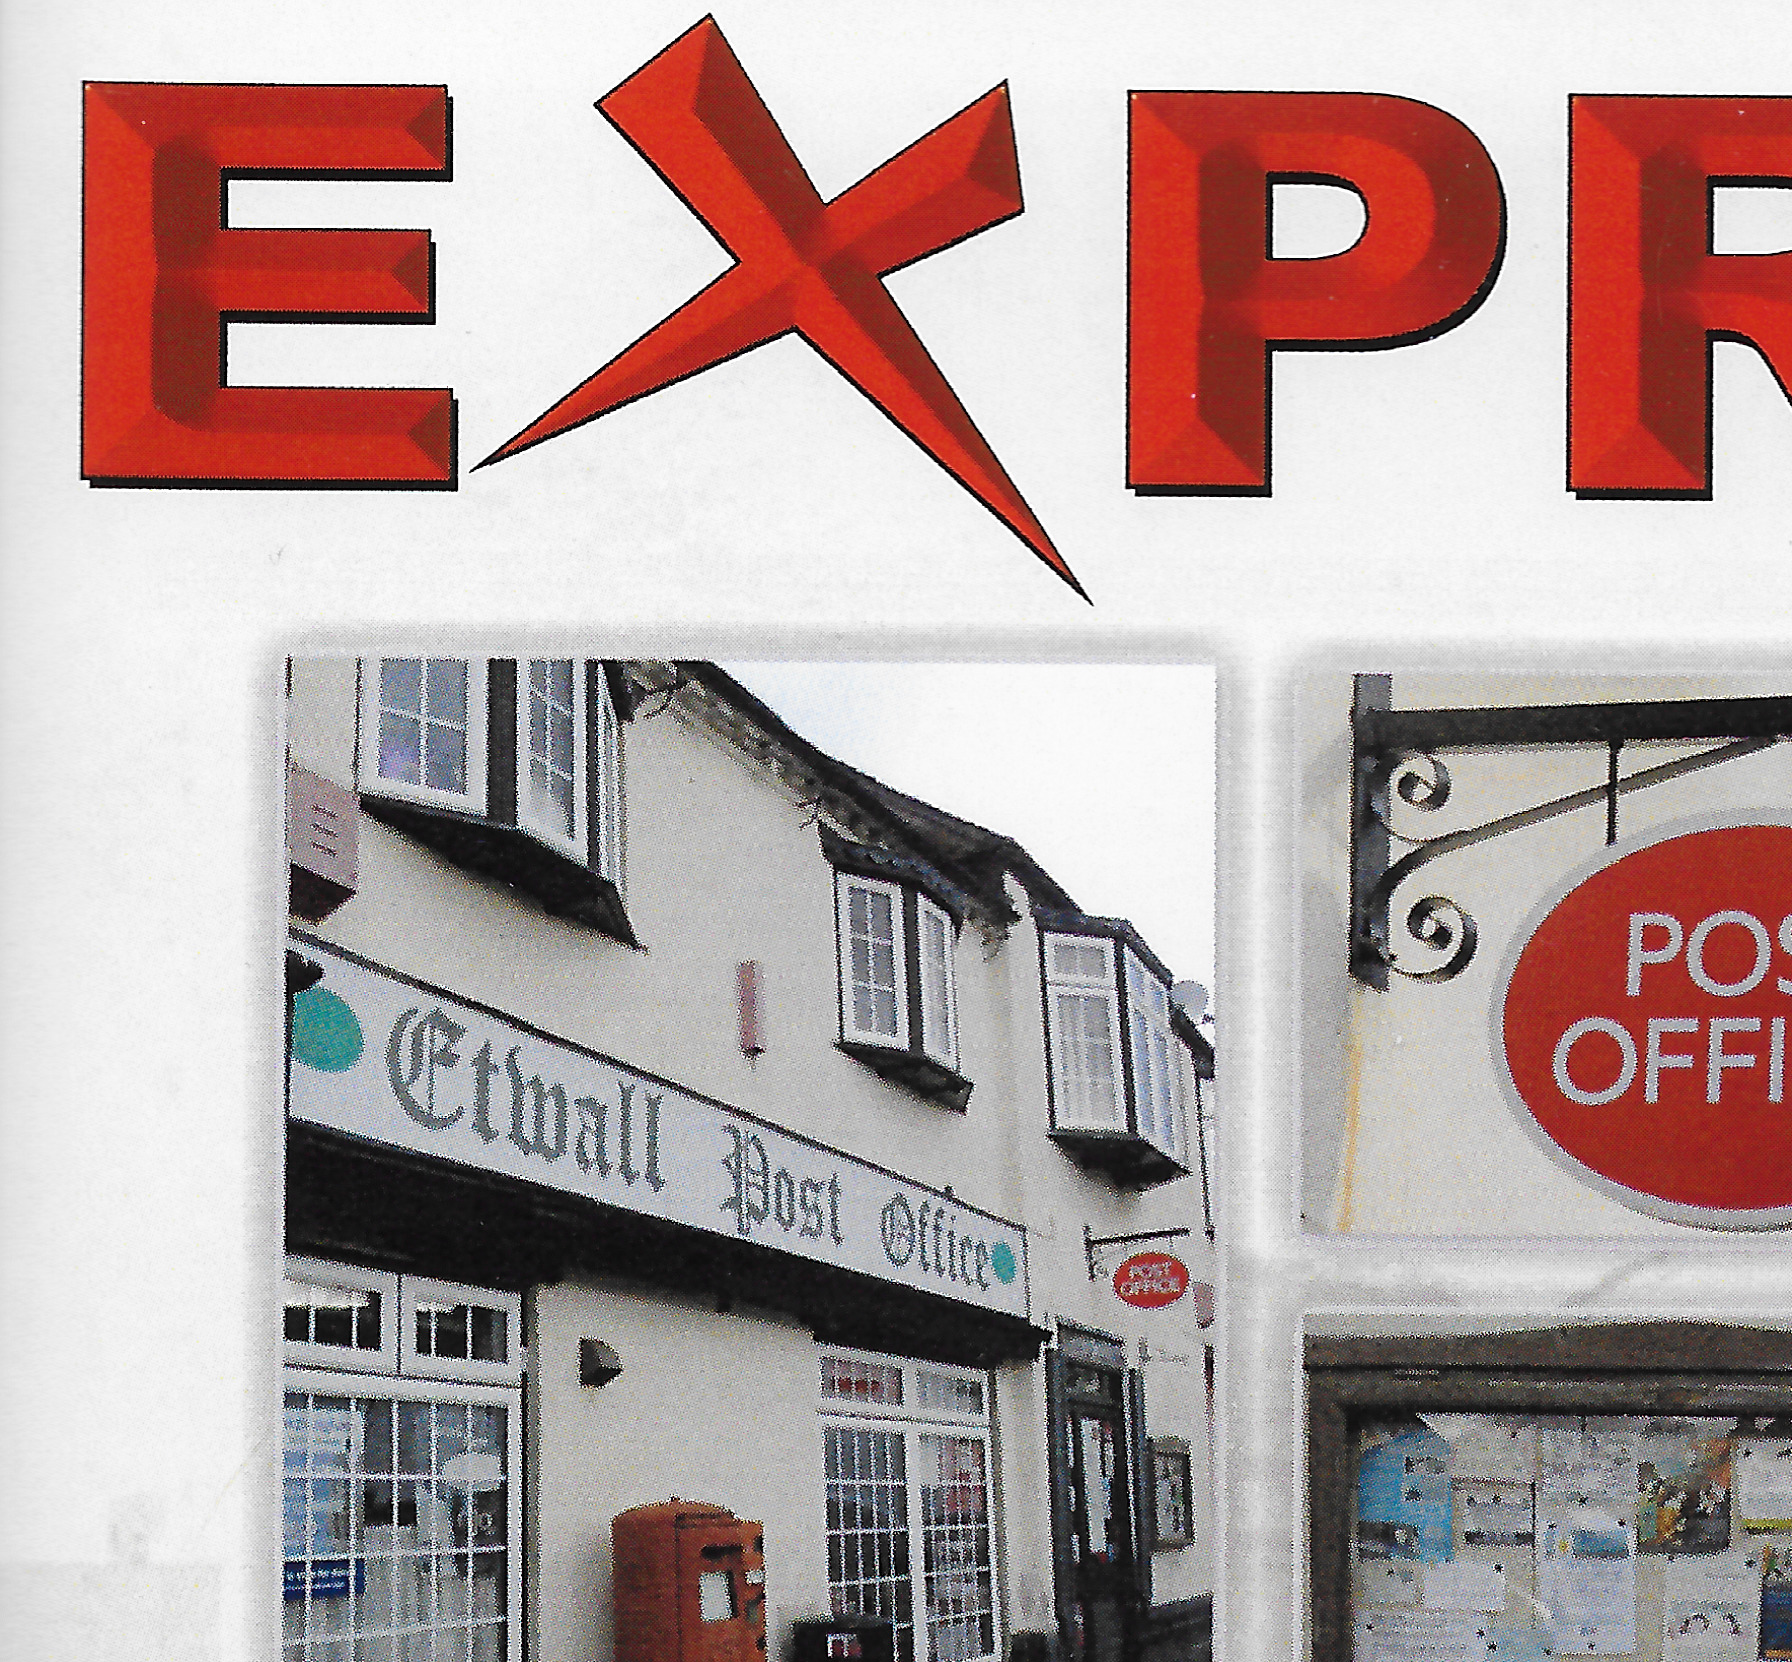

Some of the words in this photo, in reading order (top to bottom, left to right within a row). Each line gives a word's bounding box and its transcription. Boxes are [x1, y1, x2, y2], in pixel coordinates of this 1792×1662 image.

[384, 1005, 667, 1192] Etwall
[719, 1123, 844, 1246] Post
[880, 1191, 991, 1291] Office
[1129, 1261, 1172, 1278] POST
[1120, 1277, 1180, 1296] OFFICE
